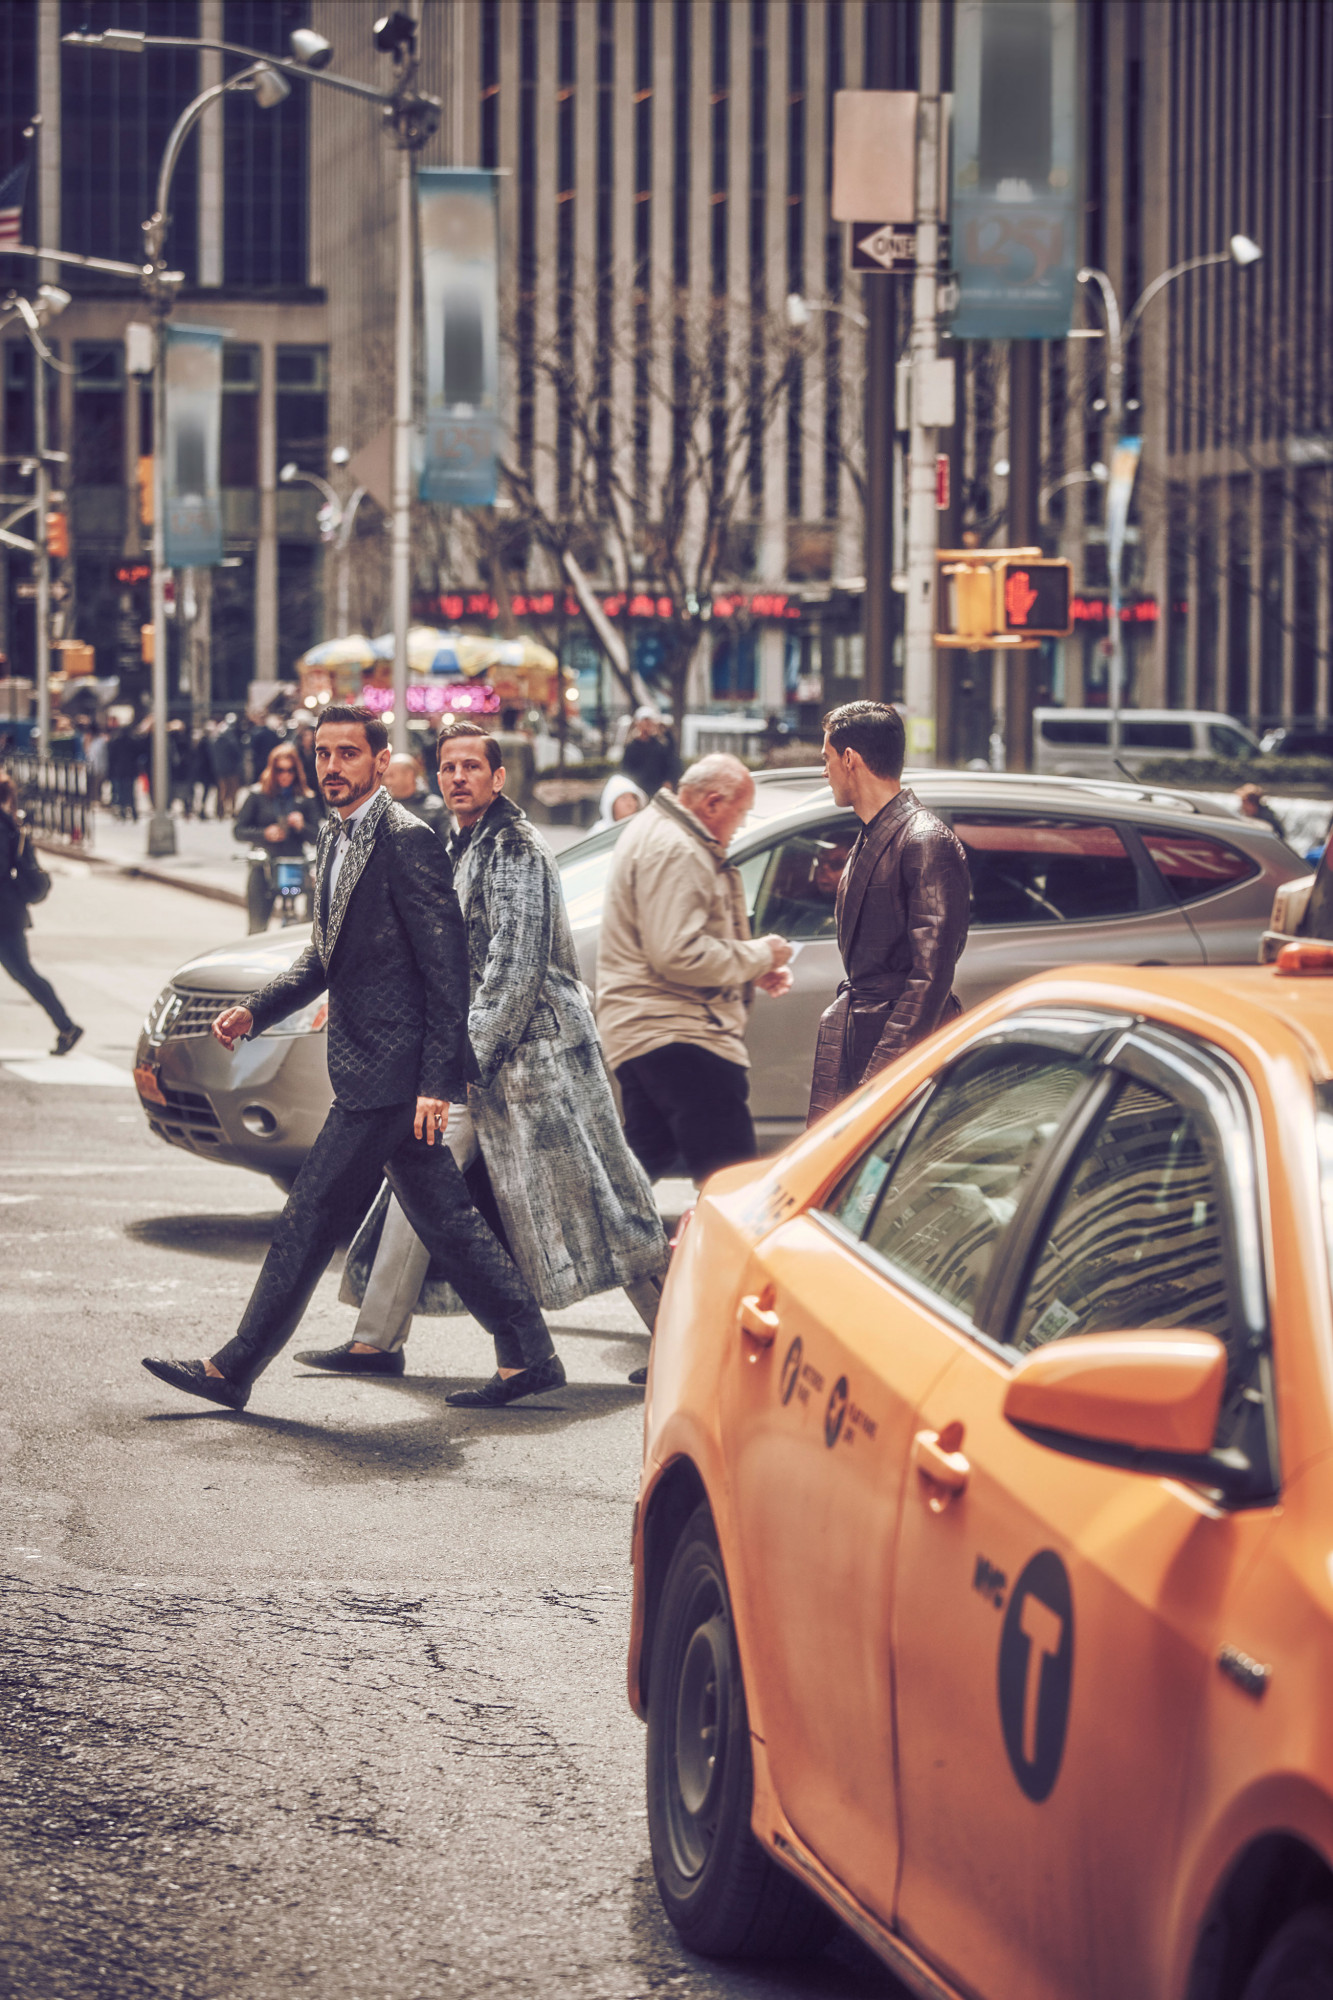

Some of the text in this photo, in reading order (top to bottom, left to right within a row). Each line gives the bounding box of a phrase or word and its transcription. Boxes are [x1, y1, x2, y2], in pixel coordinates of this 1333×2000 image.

[872, 235, 917, 257] ONE
[965, 216, 1063, 287] 1251
[1019, 1591, 1064, 1767] T
